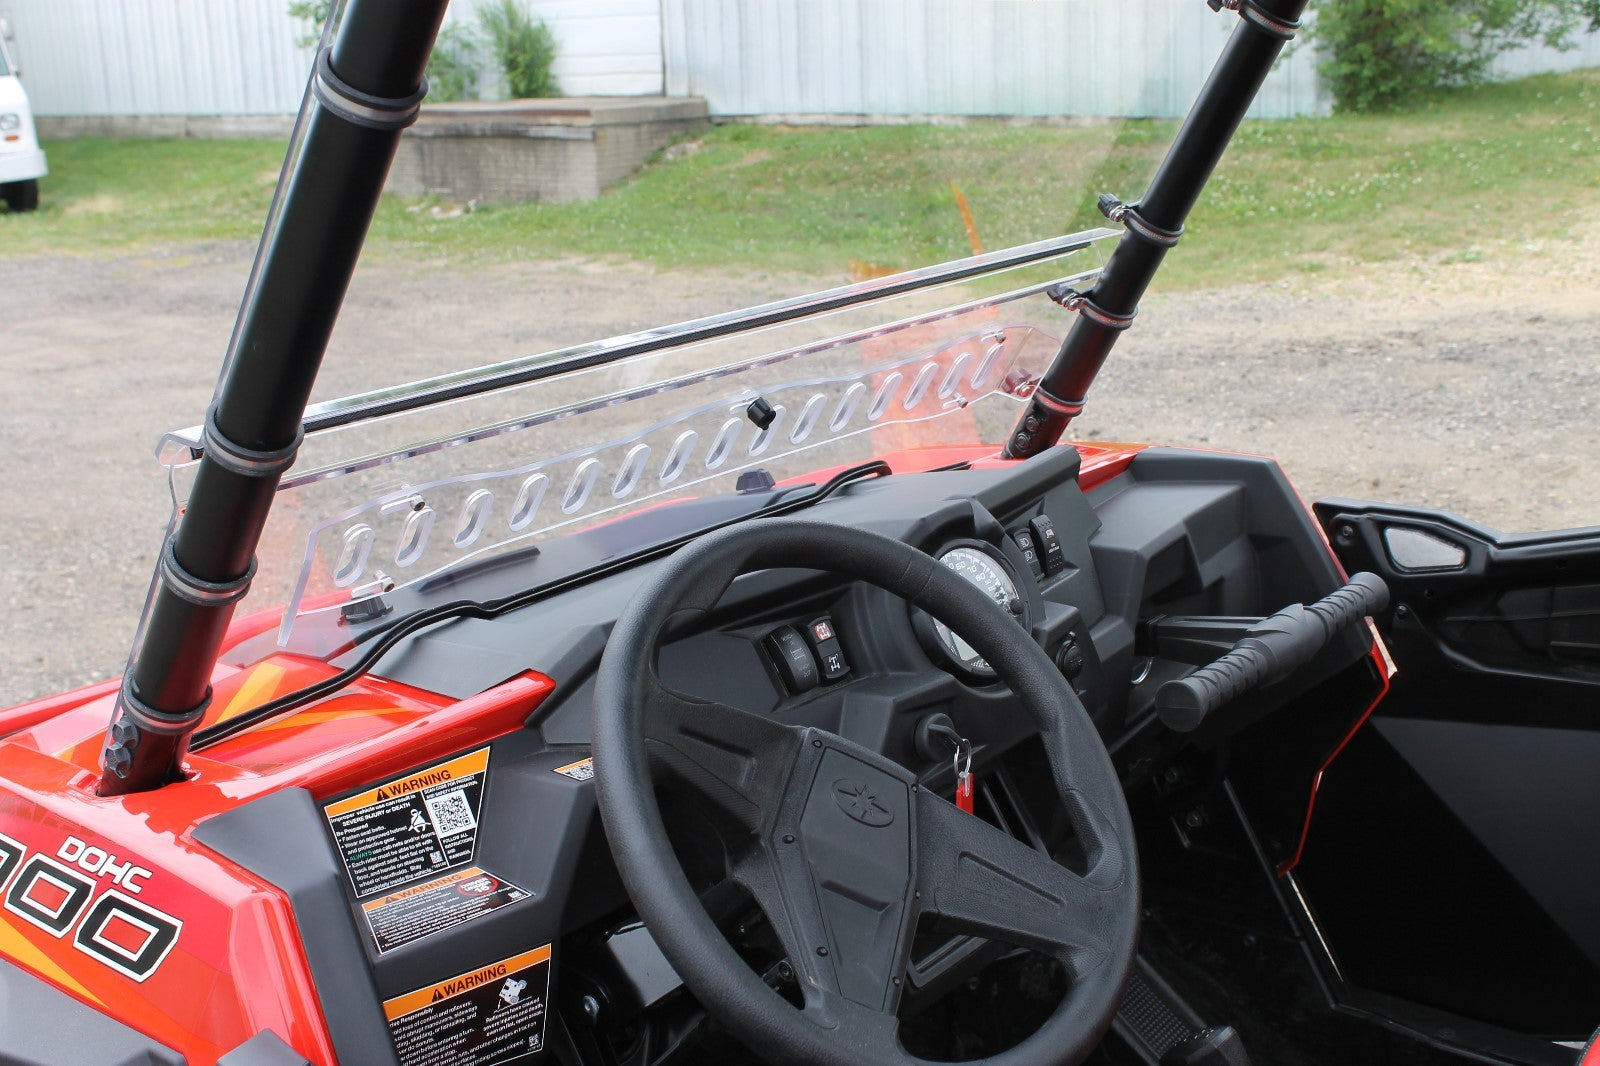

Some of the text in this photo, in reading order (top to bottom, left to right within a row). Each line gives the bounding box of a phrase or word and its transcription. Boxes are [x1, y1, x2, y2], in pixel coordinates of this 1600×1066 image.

[389, 769, 451, 796] WARNING
[331, 813, 355, 823] Improper
[356, 806, 375, 815] vehicle
[342, 816, 364, 826] SEVERE
[365, 810, 385, 820] INJURY
[392, 802, 410, 811] DEATH
[344, 823, 368, 834] Prepared
[342, 832, 360, 841] Fasten
[358, 841, 383, 852] protective
[350, 851, 372, 861] ALWAYS
[352, 859, 365, 868] Each
[55, 834, 153, 894] DOHC
[359, 878, 374, 888] wheel
[400, 874, 461, 898] WARNING
[0, 832, 184, 984] 00
[444, 964, 507, 996] WARNING
[400, 1007, 434, 1023] Responsibly
[420, 1014, 438, 1024] control
[439, 1009, 448, 1017] and
[466, 1012, 477, 1020] and
[485, 1010, 510, 1023] Rollovers
